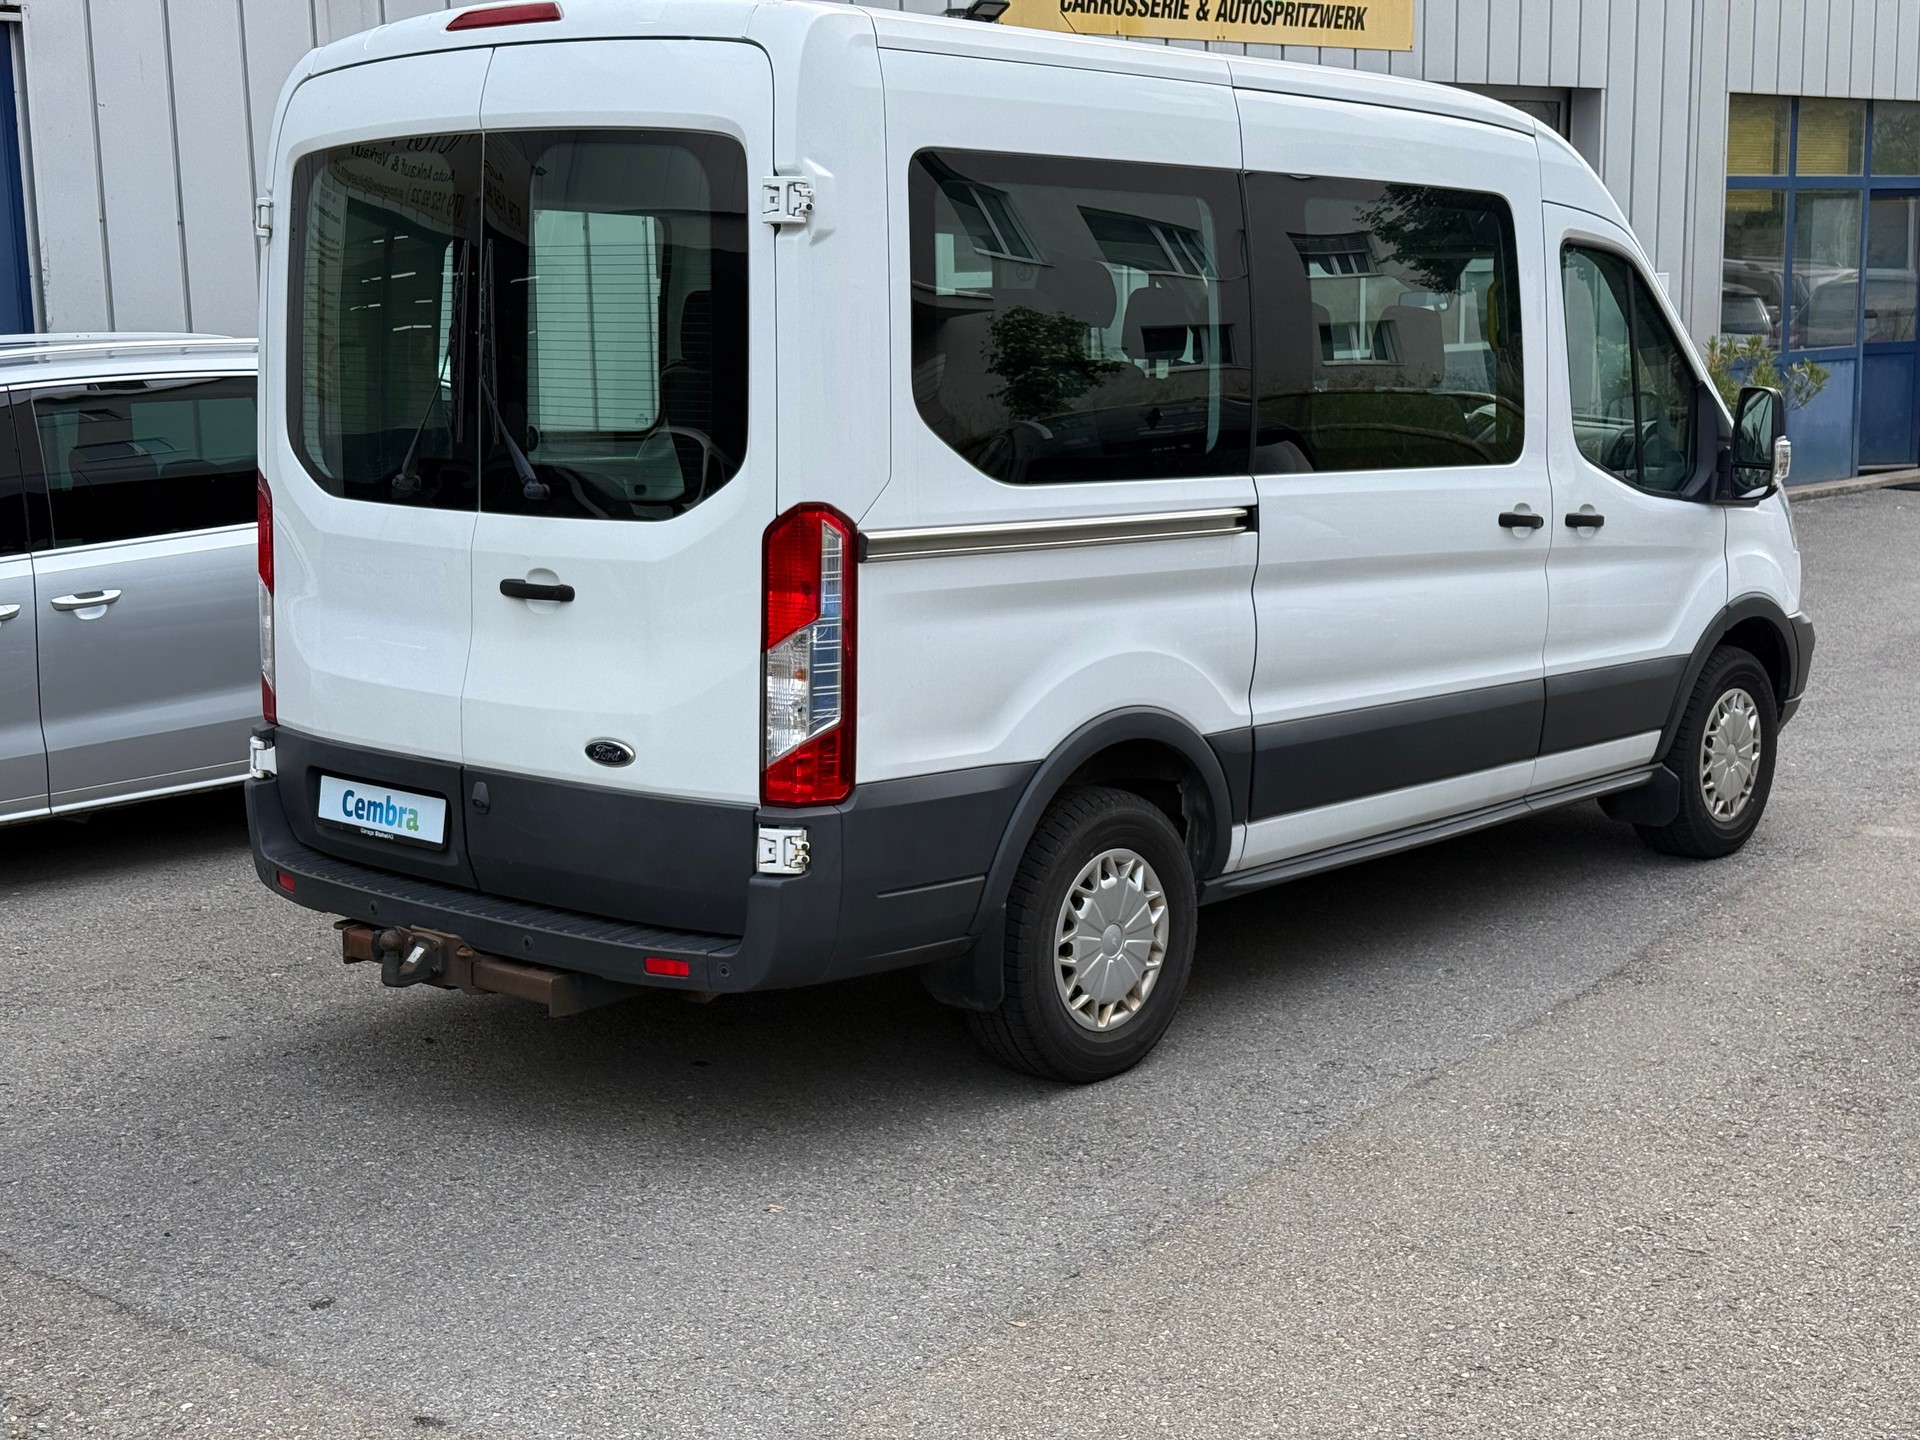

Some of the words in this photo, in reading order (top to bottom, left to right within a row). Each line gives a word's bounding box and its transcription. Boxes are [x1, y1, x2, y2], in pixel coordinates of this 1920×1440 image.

[1060, 0, 1190, 20] CARROSSERIE
[1196, 0, 1210, 21] &
[1215, 0, 1368, 31] AUTOSPRITZWERK
[593, 744, 621, 761] Ford
[342, 789, 419, 832] Cembra
